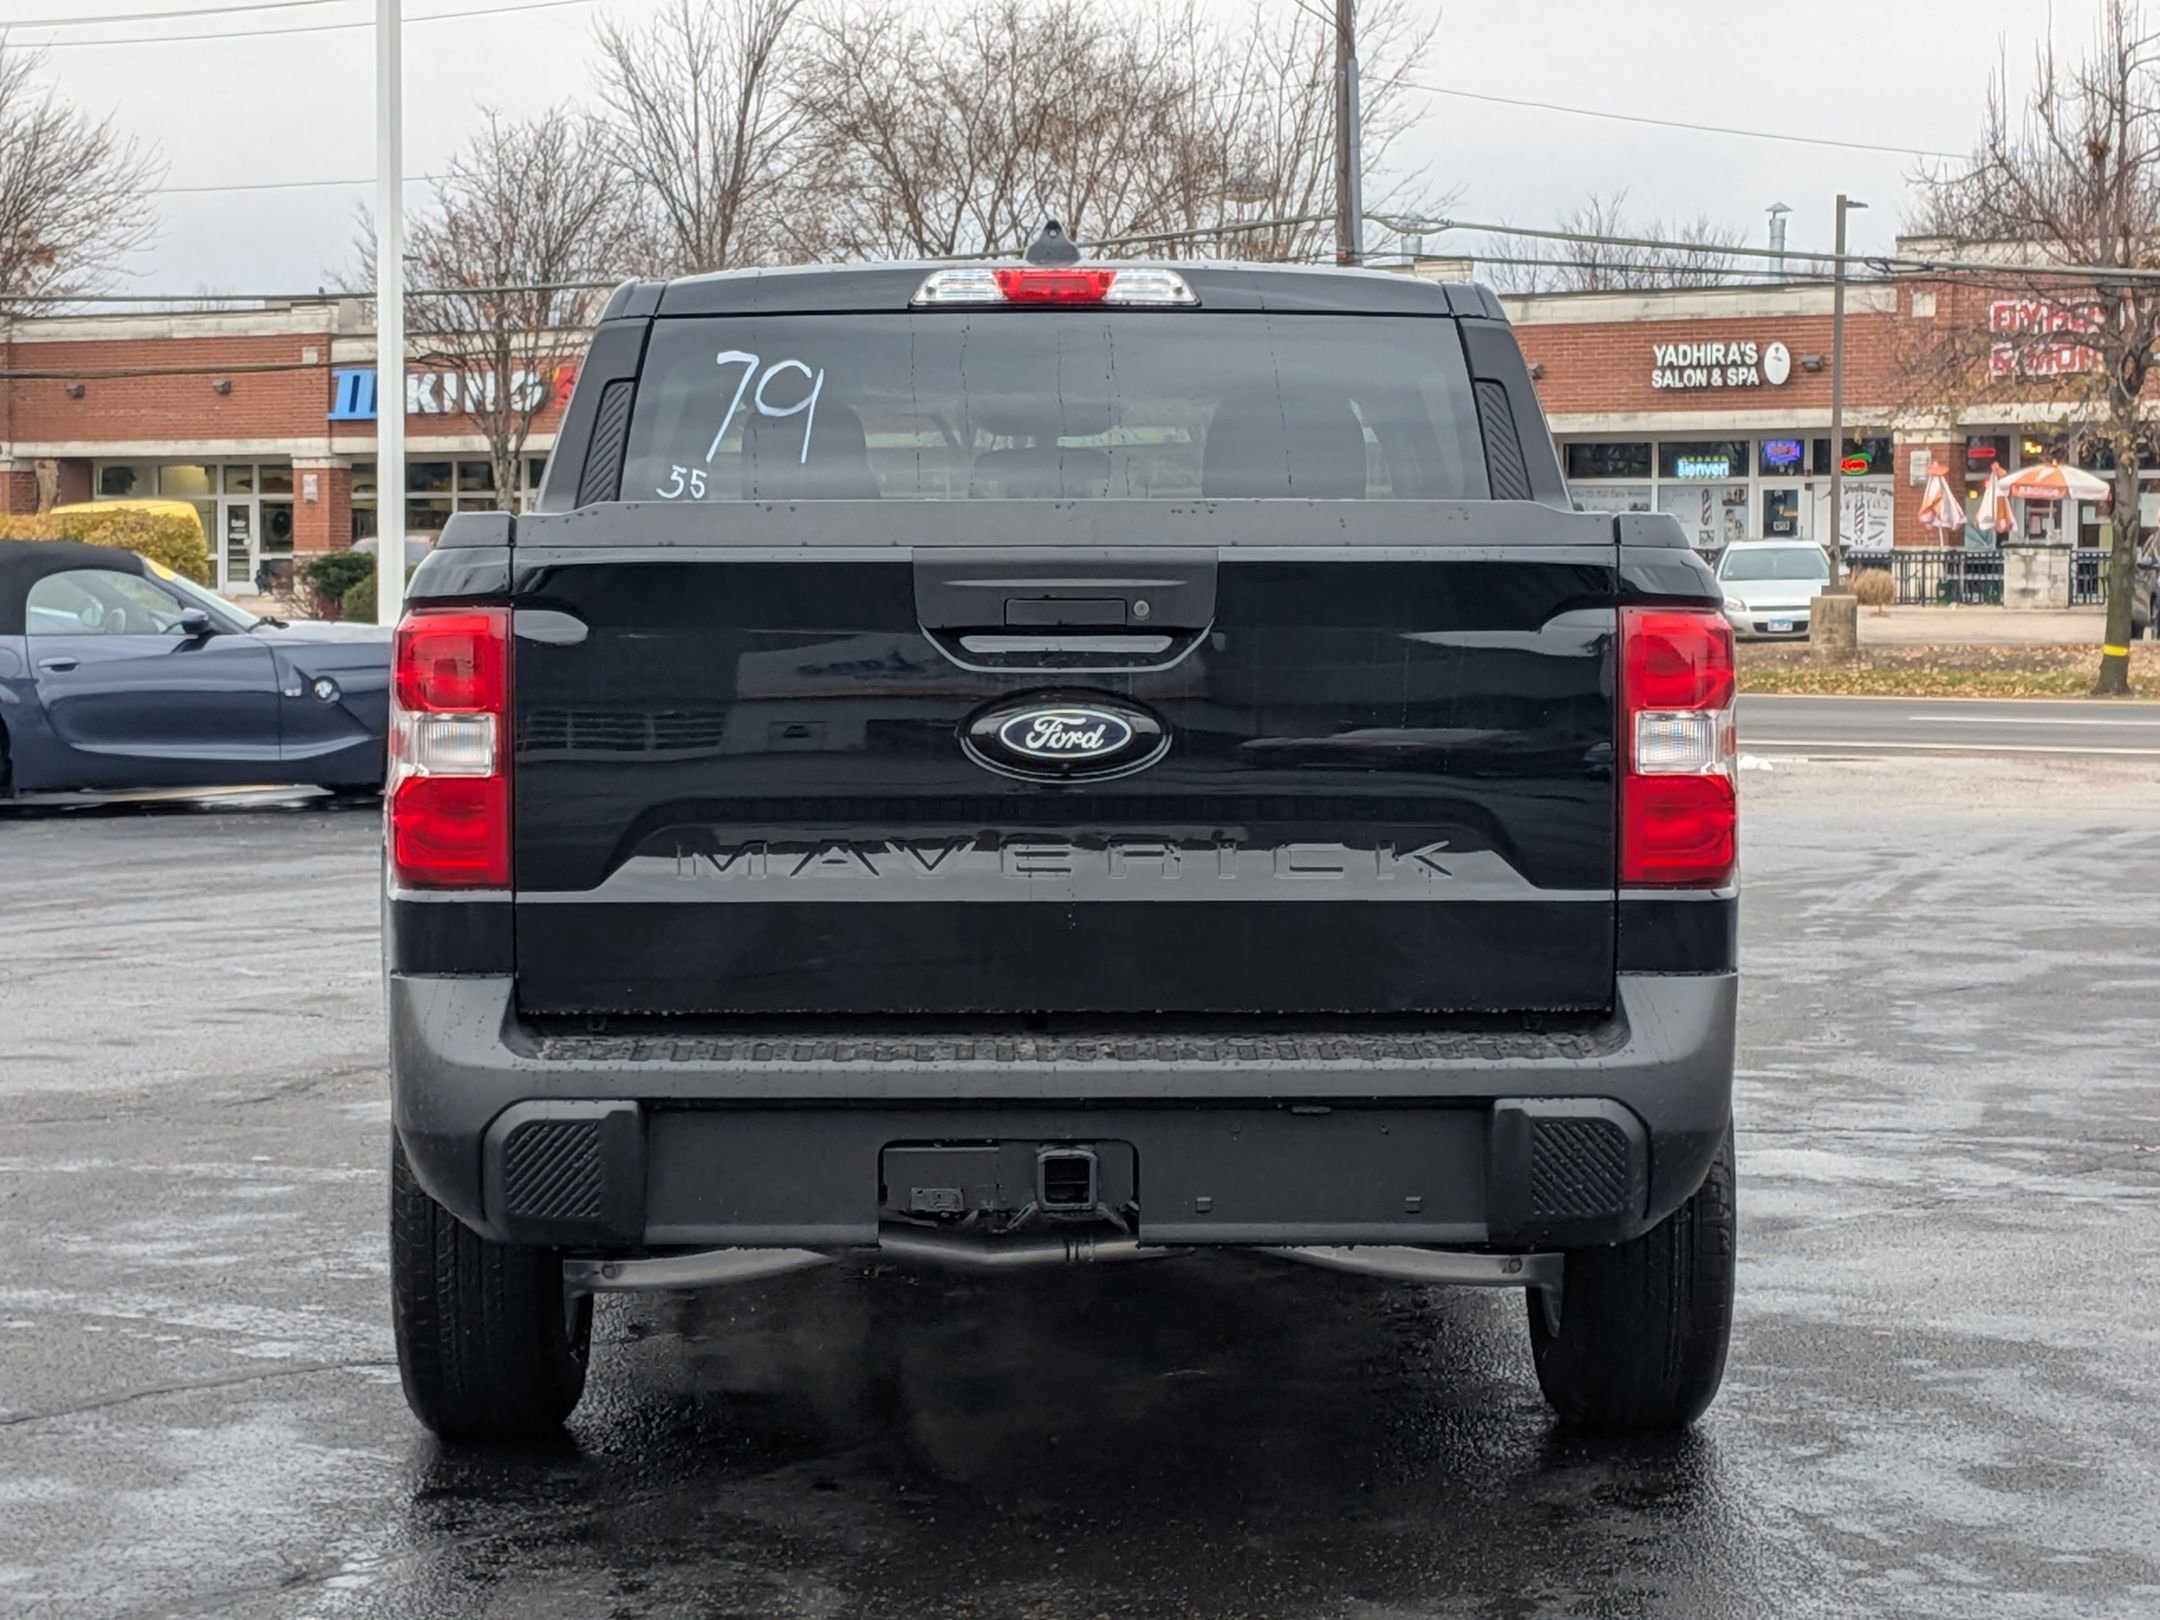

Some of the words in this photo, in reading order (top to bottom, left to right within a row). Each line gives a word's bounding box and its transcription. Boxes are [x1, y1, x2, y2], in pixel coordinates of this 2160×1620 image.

[1653, 342, 1758, 366] YADHIRA'S
[1652, 369, 1707, 388] SALON
[1710, 368, 1723, 387] &
[1727, 367, 1760, 387] SPA
[706, 351, 824, 463] 79
[656, 465, 707, 498] 55
[1025, 716, 1107, 749] Ford
[676, 840, 1454, 880] MAVERICK
